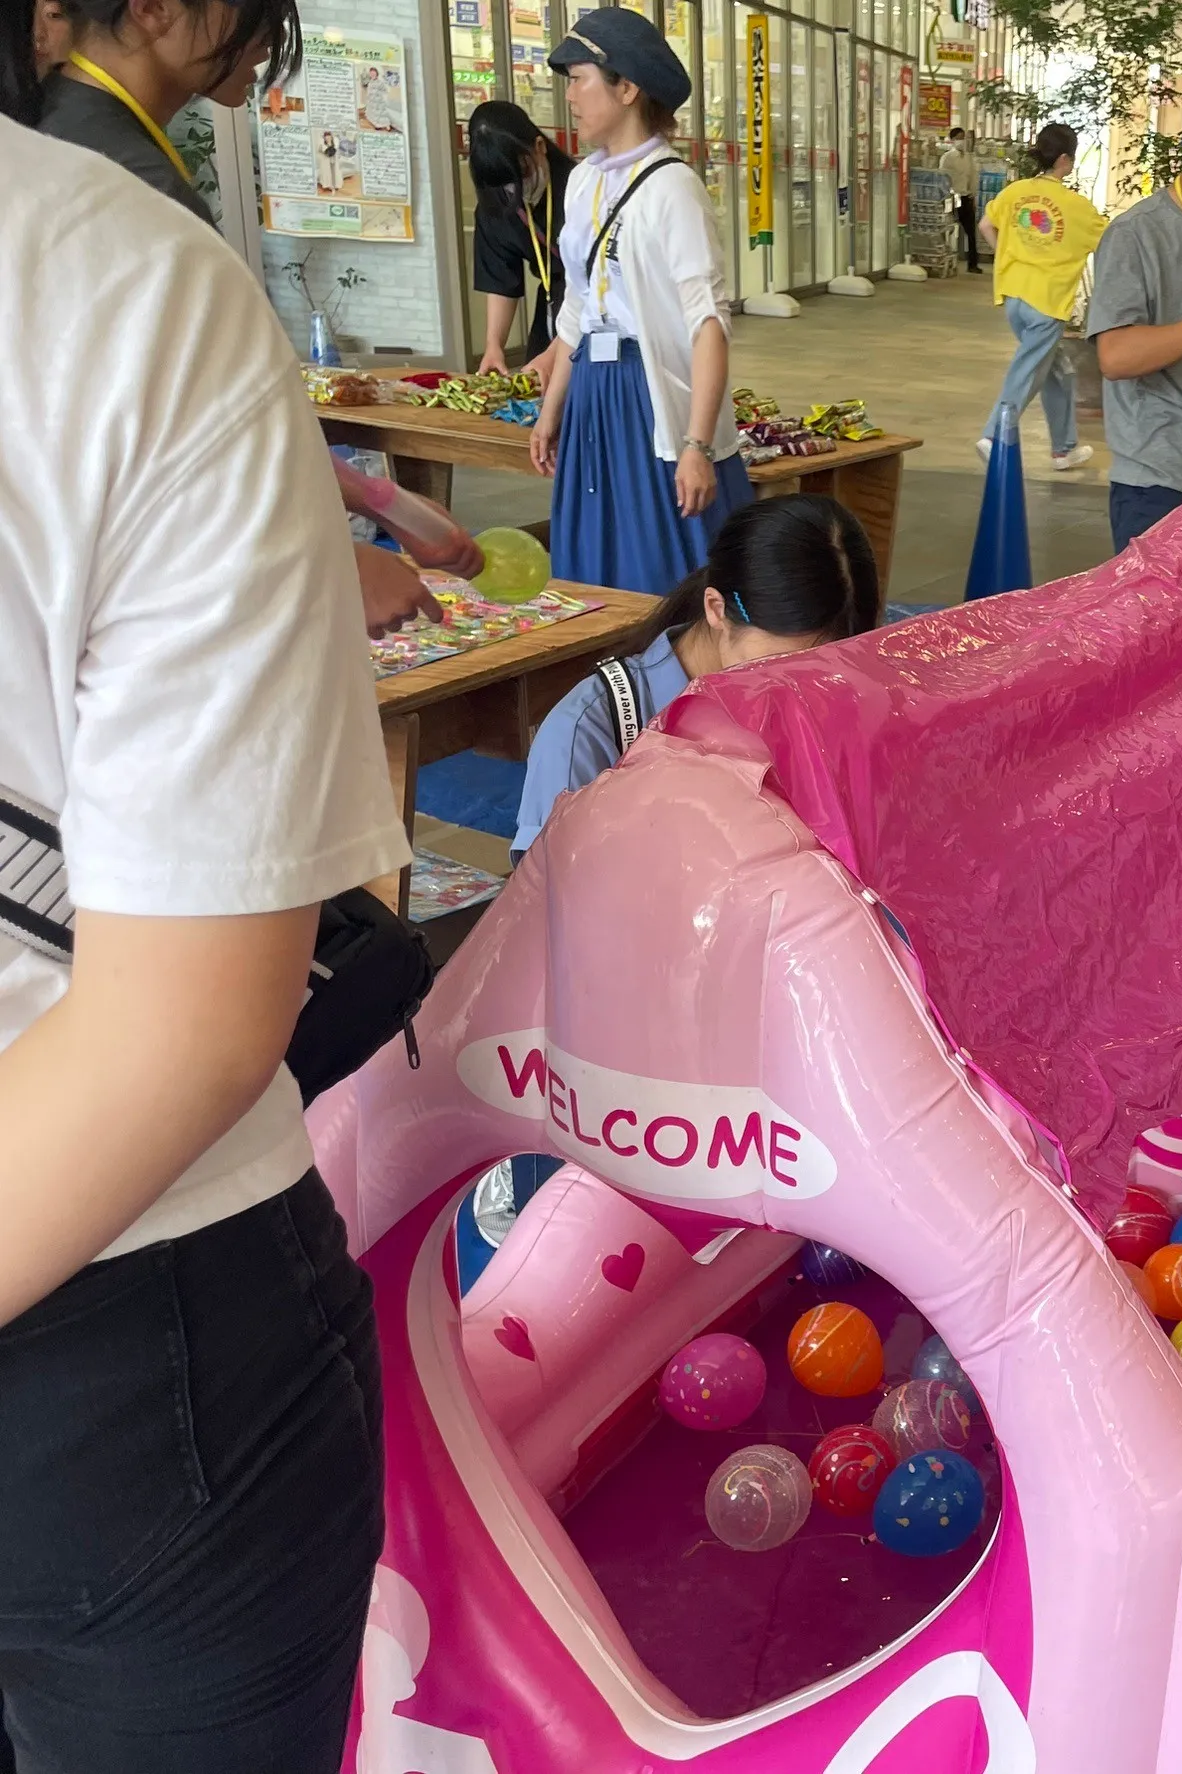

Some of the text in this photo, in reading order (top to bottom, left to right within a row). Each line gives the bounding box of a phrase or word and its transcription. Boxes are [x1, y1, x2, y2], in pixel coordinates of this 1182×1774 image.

[611, 674, 628, 695] with
[620, 697, 631, 721] over
[497, 1044, 802, 1188] WELCOME
